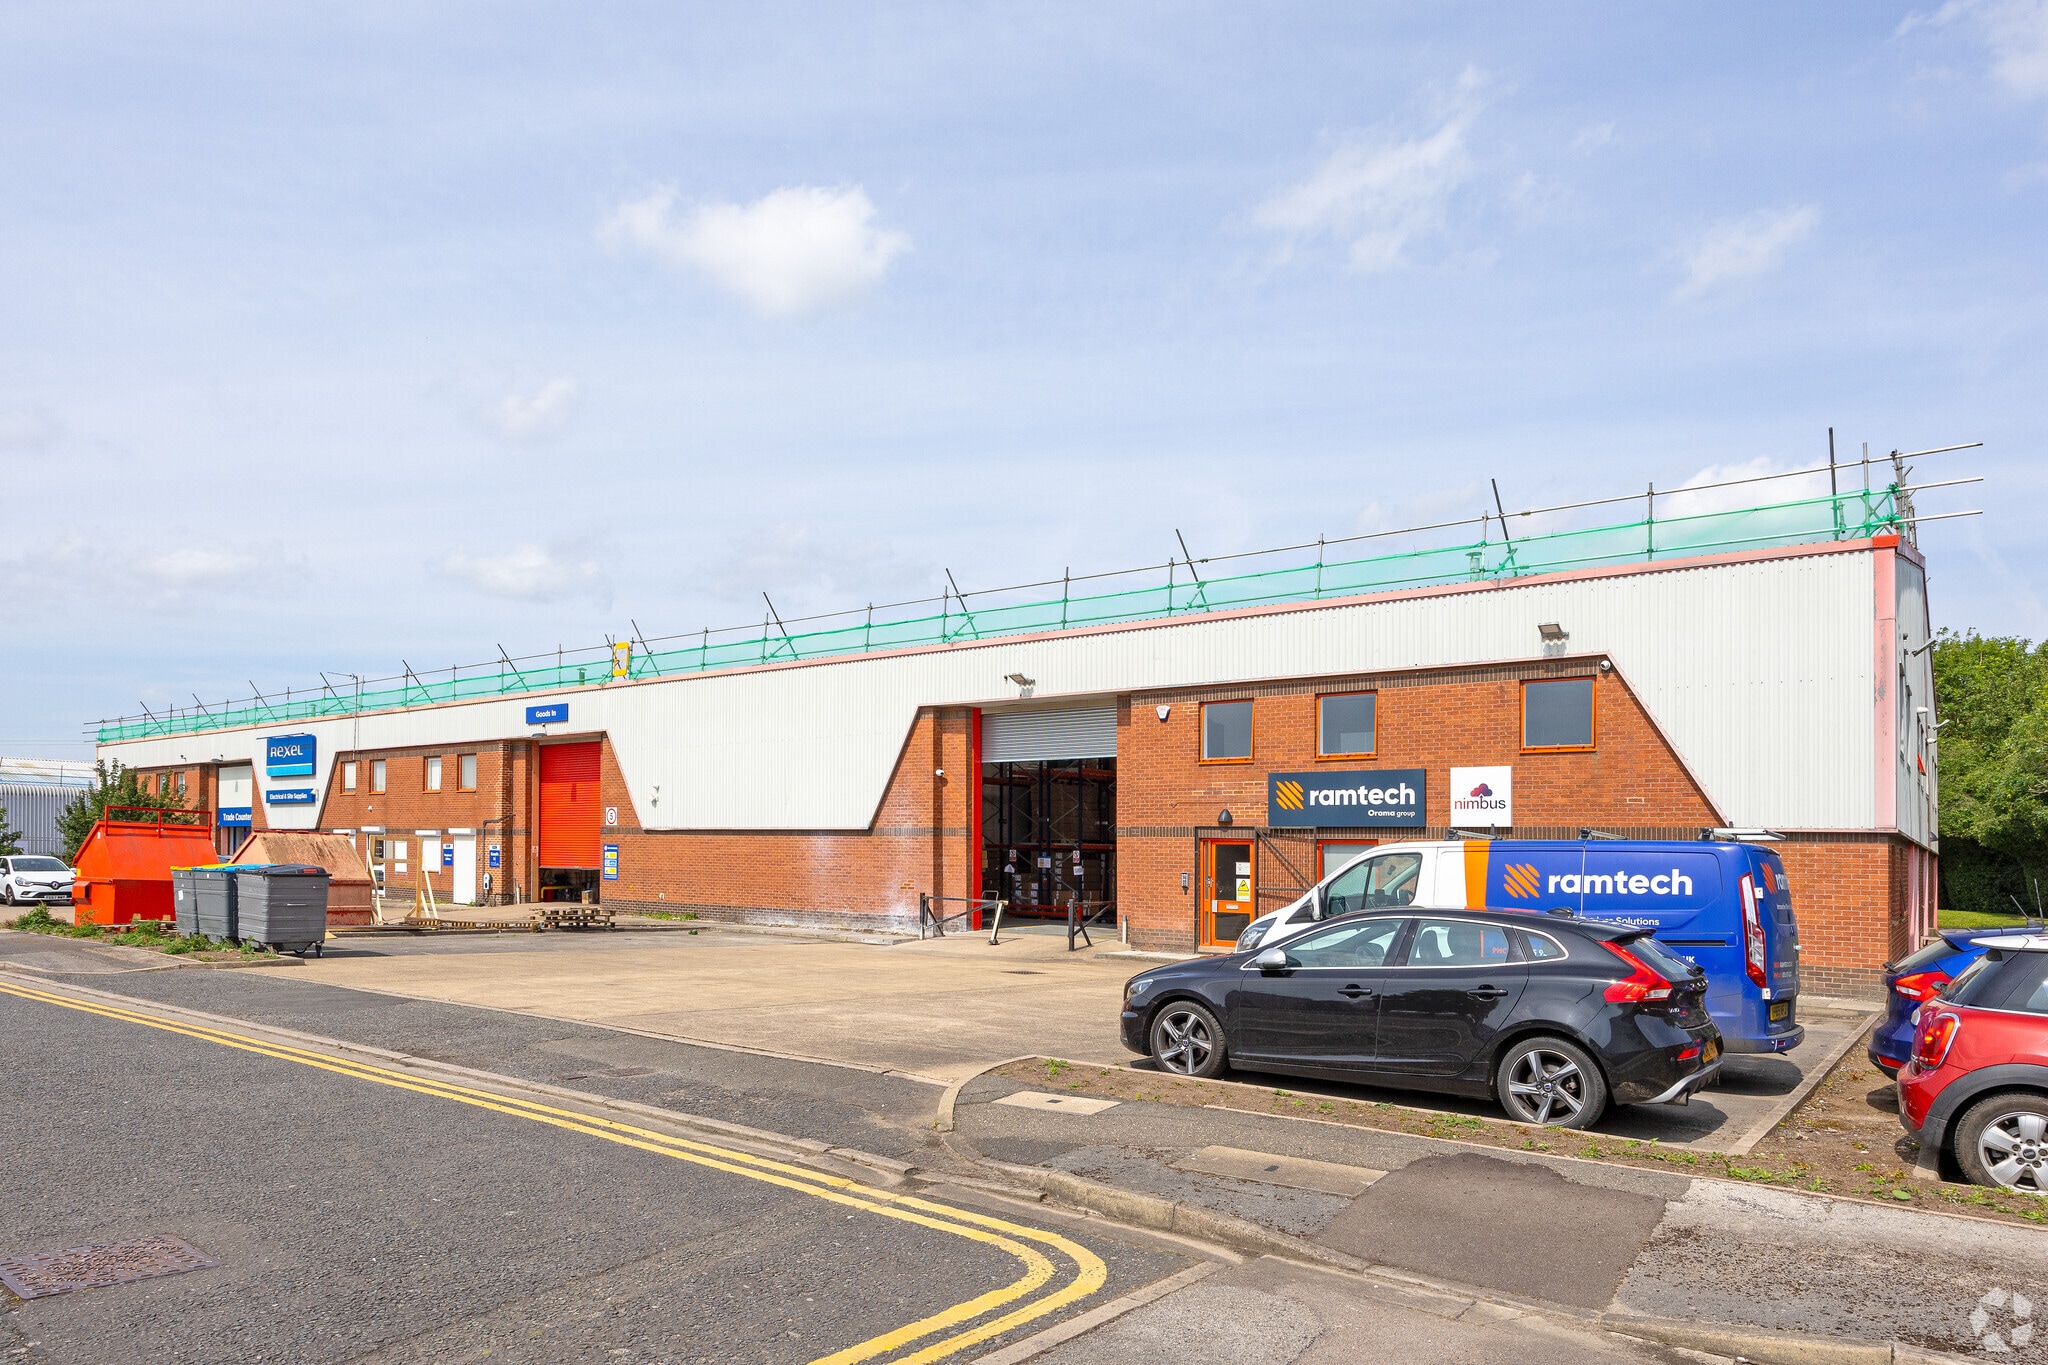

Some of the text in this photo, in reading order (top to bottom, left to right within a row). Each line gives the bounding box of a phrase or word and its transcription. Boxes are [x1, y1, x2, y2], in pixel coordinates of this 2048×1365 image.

[535, 709, 557, 718] Goods In
[1309, 782, 1416, 806] ramtech
[1454, 796, 1507, 810] nimbus
[223, 812, 252, 821] Trade Counter
[609, 812, 614, 821] 5
[1367, 809, 1416, 818] Orama group
[1548, 868, 1693, 896] ramtech
[1615, 916, 1660, 926] Solutions
